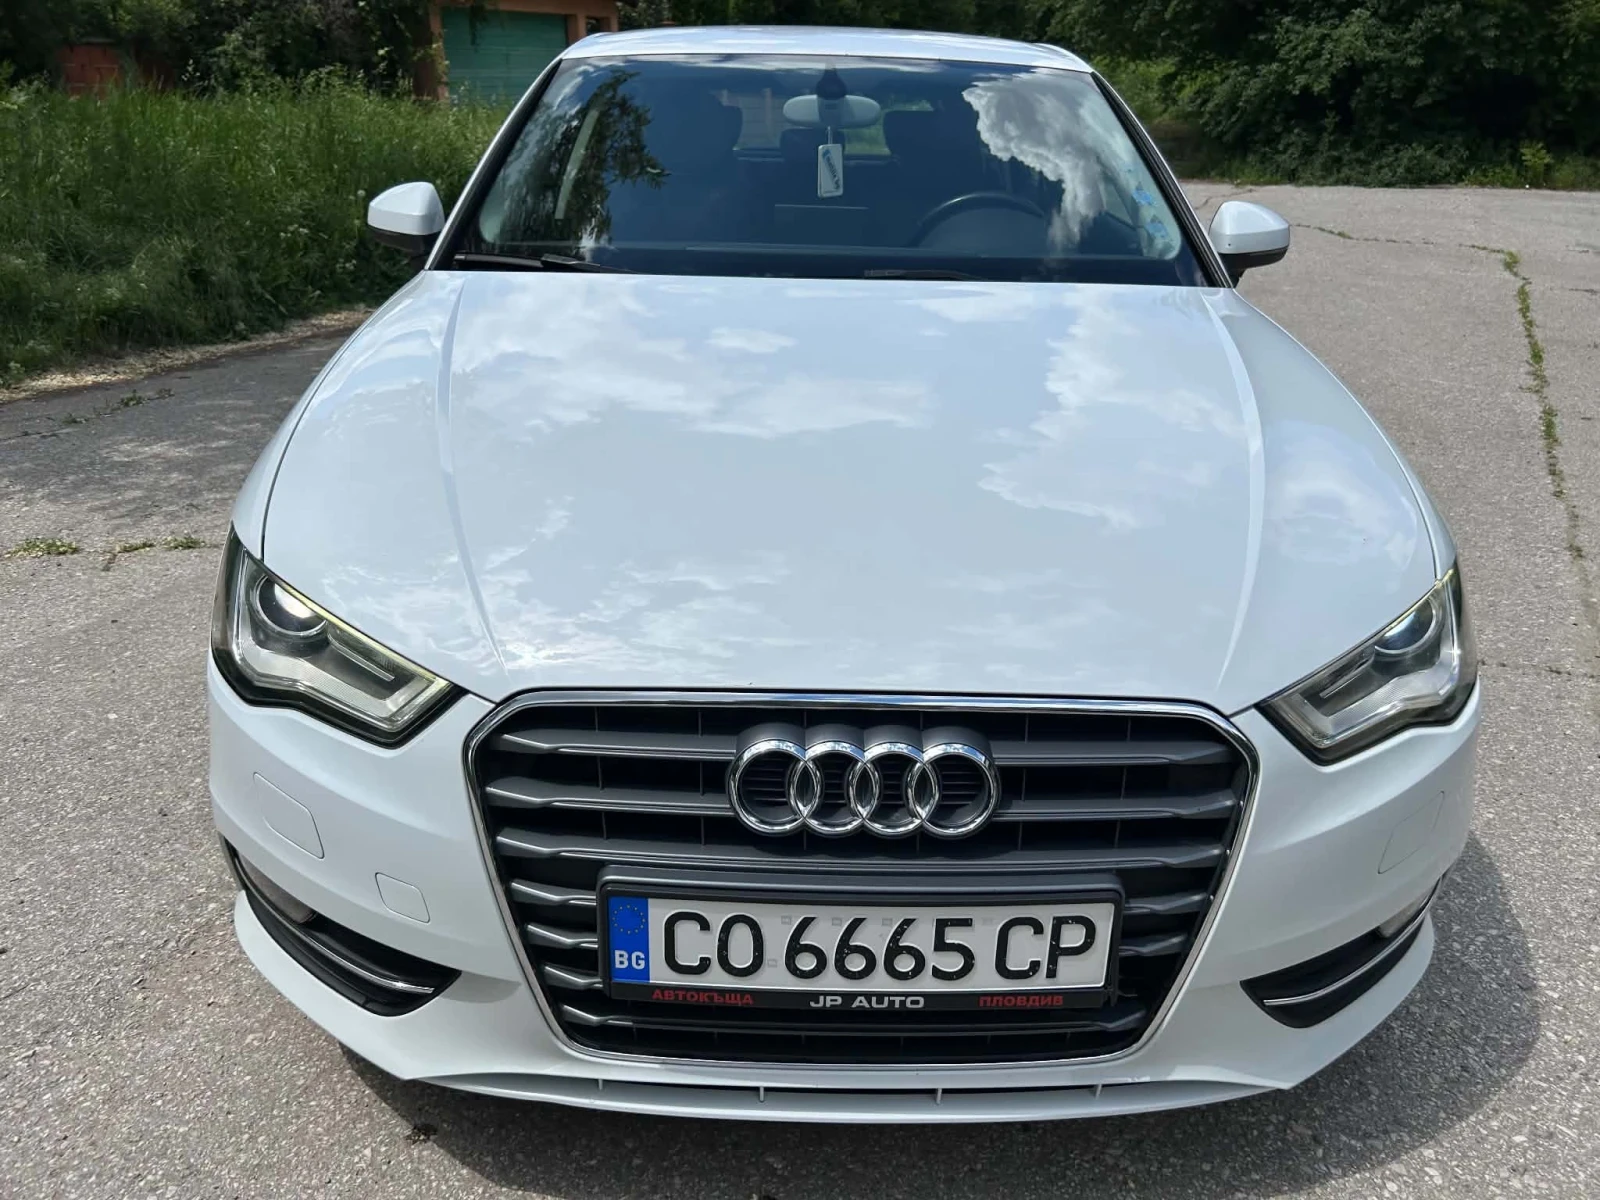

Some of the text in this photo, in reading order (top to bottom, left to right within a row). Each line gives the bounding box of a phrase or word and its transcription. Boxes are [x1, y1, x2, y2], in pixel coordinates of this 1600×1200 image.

[784, 916, 976, 981] 6665
[614, 950, 646, 970] BG
[651, 989, 755, 1007] АВТОКЪЩА
[809, 995, 926, 1009] JP AUTO
[978, 995, 1064, 1009] ПЛОВДИВ
